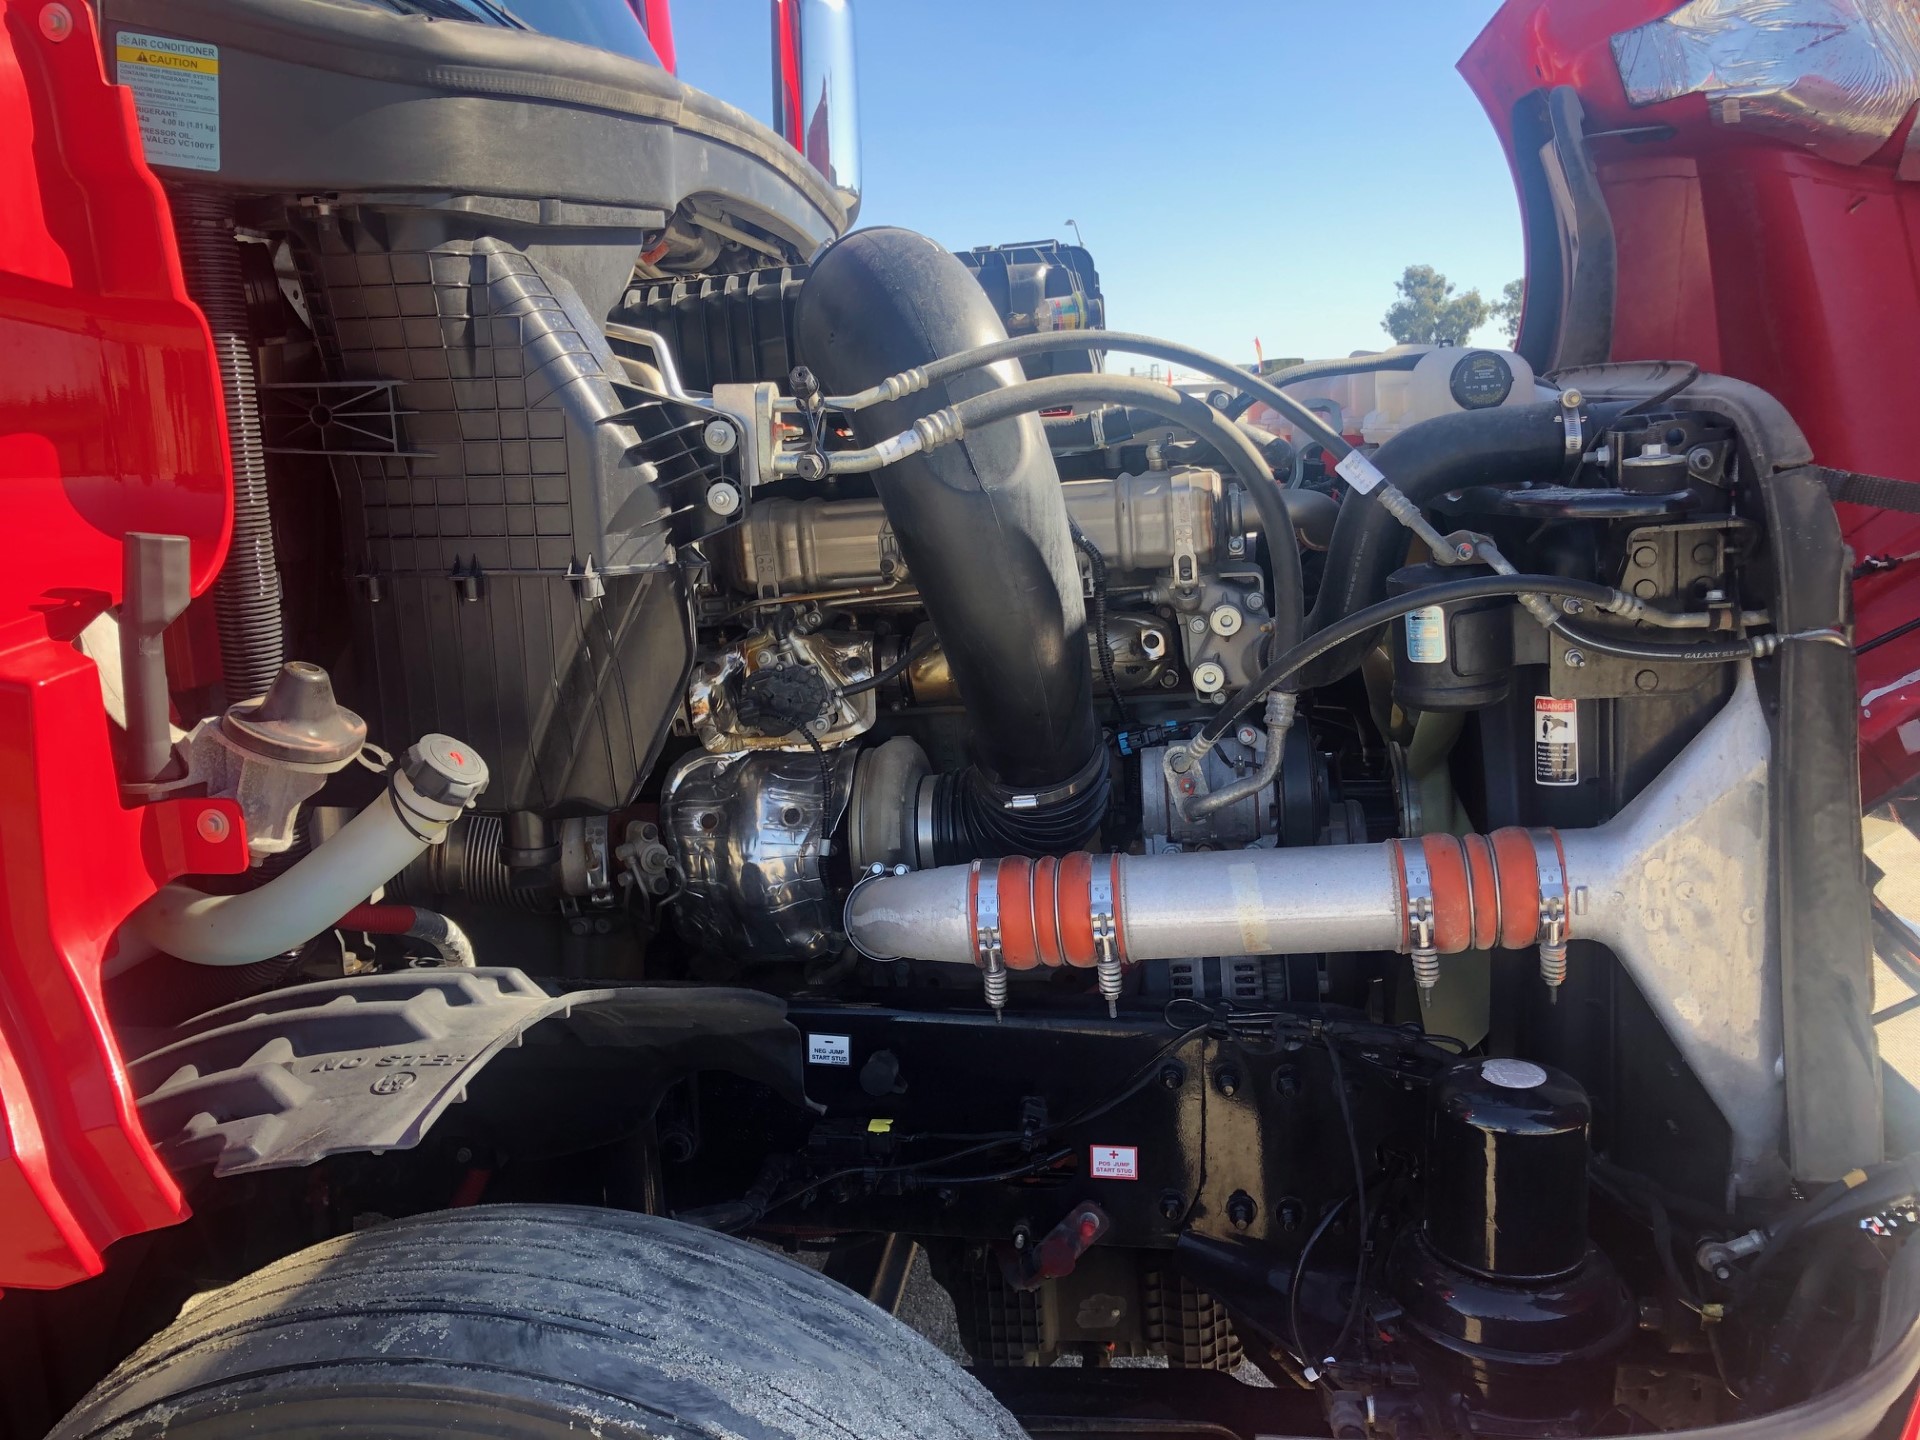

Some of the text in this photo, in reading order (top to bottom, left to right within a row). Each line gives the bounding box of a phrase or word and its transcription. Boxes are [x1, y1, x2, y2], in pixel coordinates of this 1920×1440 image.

[131, 37, 214, 57] AIR CONDITIONER
[149, 54, 198, 68] CAUTION
[136, 106, 177, 117] RIGERANT:
[162, 118, 176, 126] 4.00
[186, 121, 204, 130] (1.81
[205, 123, 216, 132] kg)
[139, 127, 176, 138] PRESSOR
[178, 140, 215, 150] VC100YF
[1542, 702, 1573, 710] DANGER
[310, 1054, 468, 1073] NO STEP
